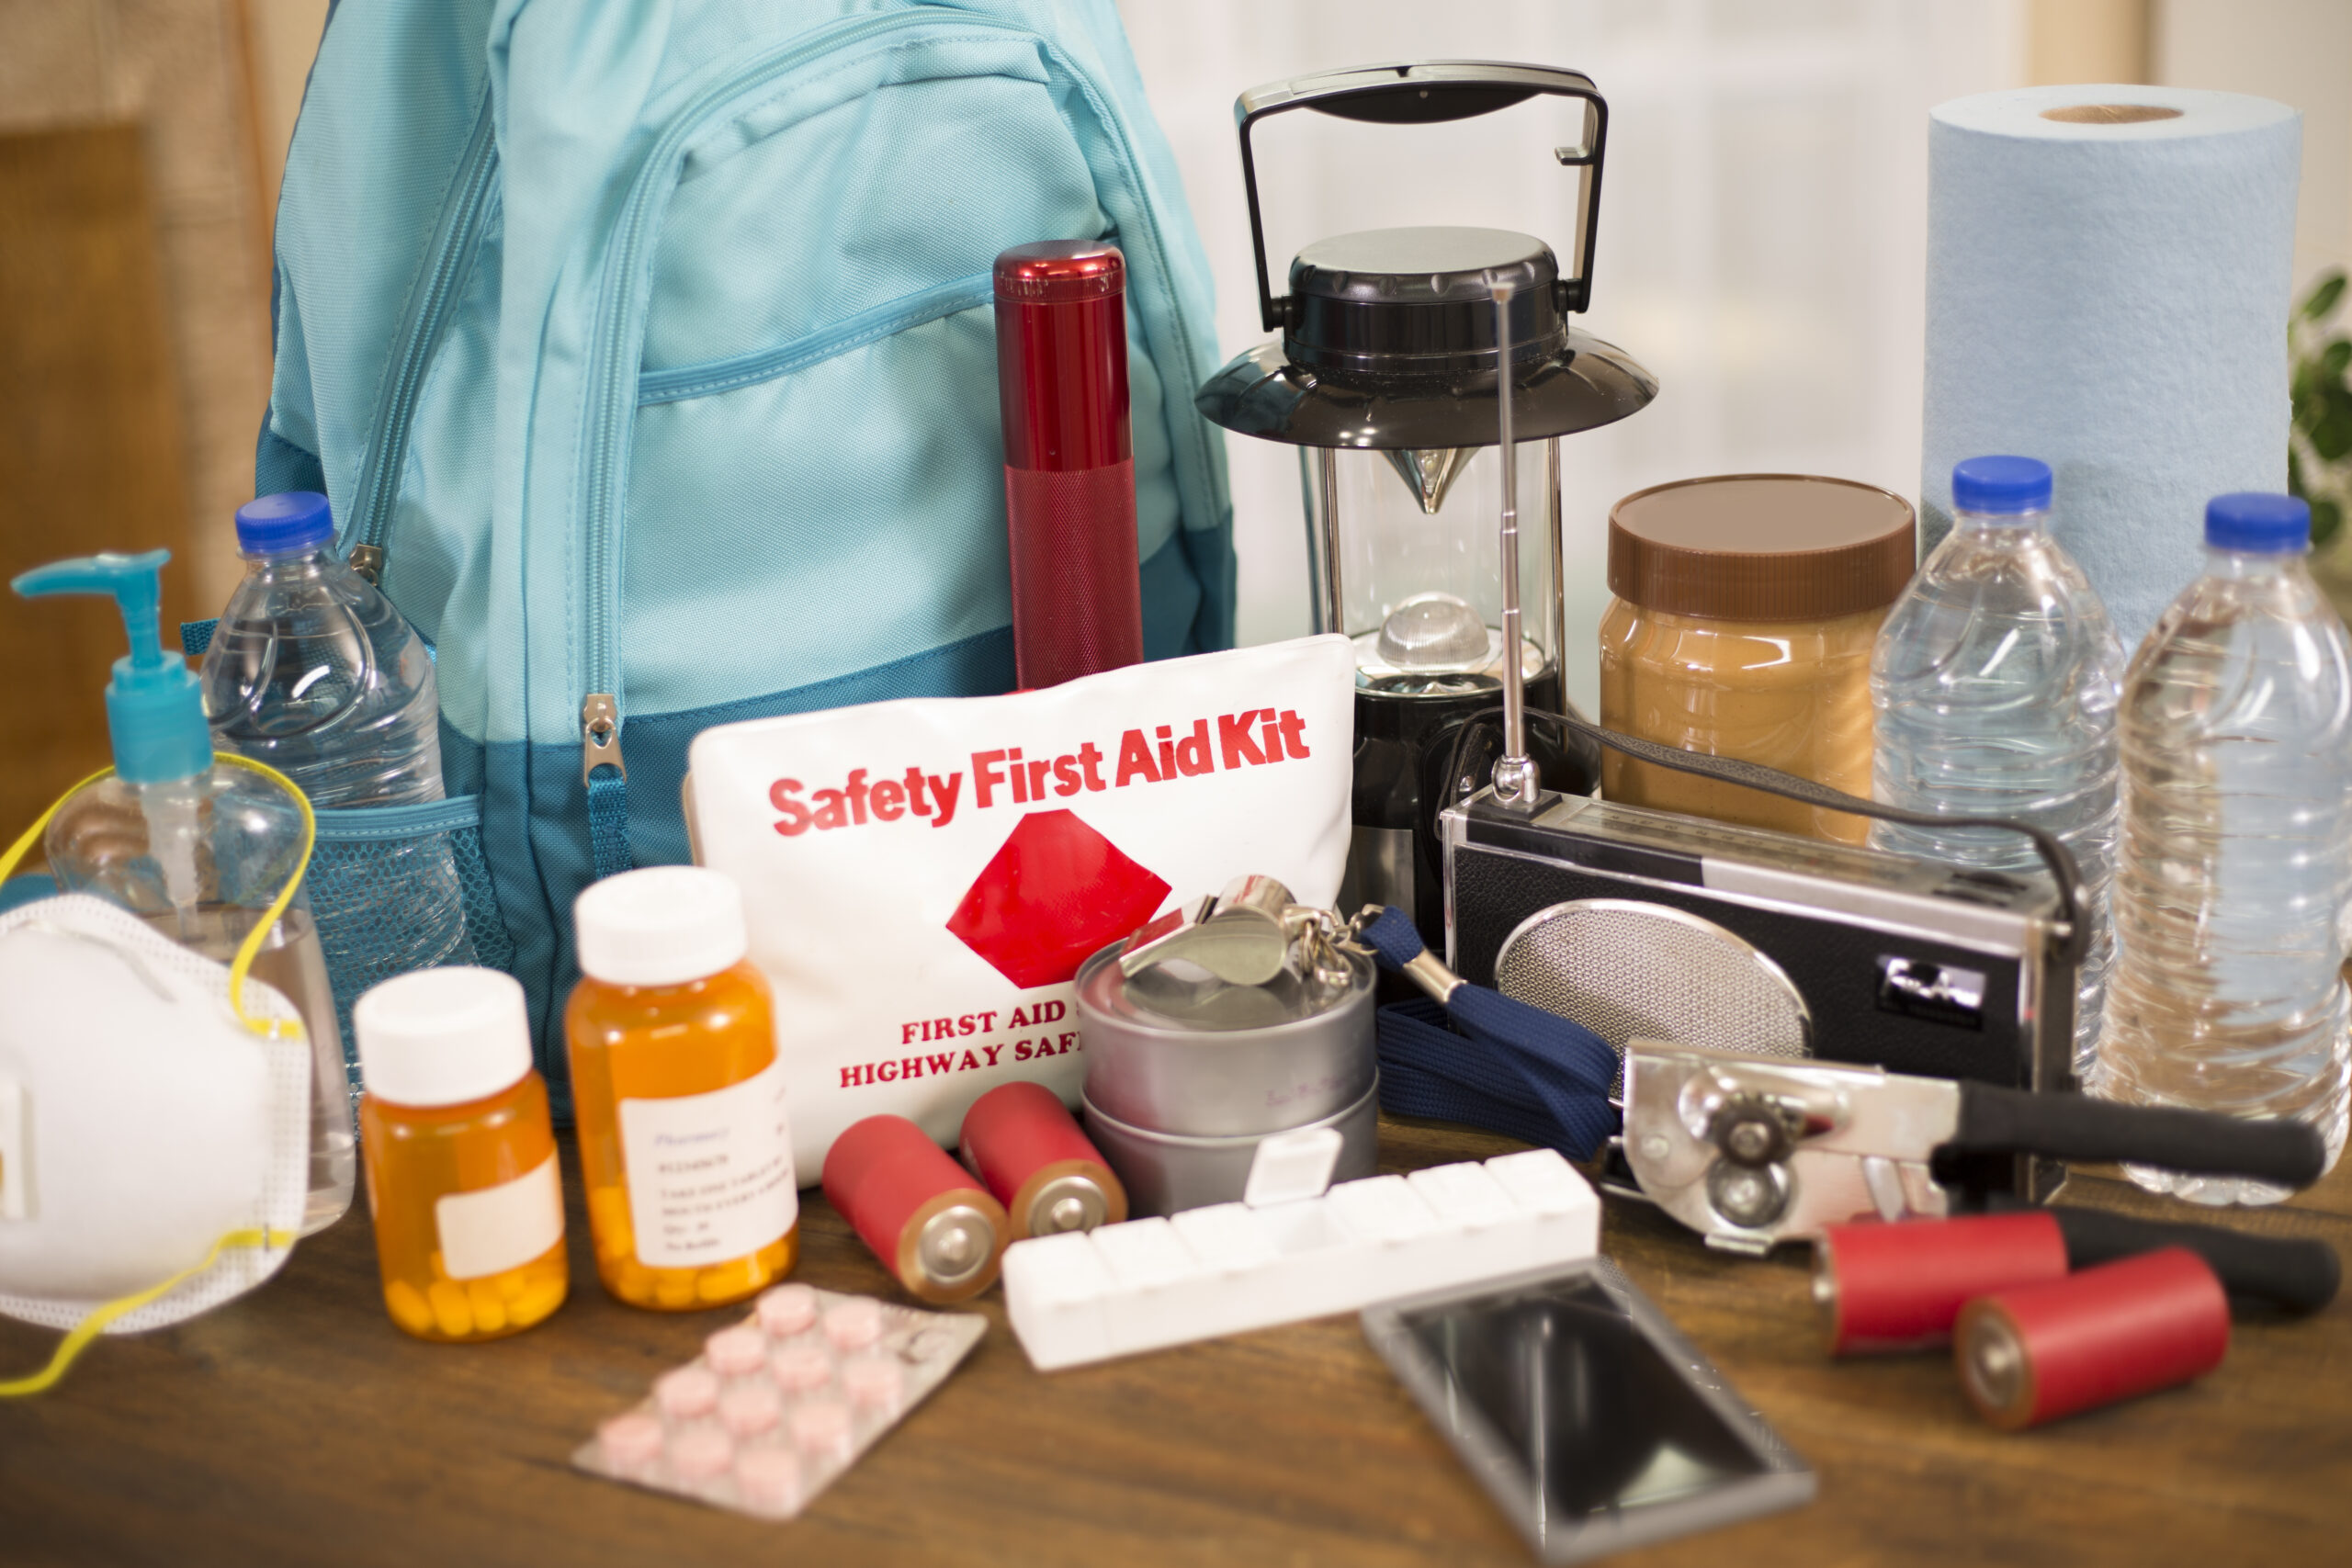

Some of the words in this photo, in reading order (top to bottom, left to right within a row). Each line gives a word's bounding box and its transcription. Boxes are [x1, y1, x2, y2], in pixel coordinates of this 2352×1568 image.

[768, 766, 963, 838] Safety
[970, 741, 1107, 809] First
[1114, 717, 1216, 788] Aid
[1216, 706, 1311, 771] Kit
[901, 1010, 998, 1045] FIRST
[1008, 999, 1067, 1030] AID
[840, 1043, 1005, 1089] HIGHWAY
[1014, 1031, 1081, 1062] SAF
